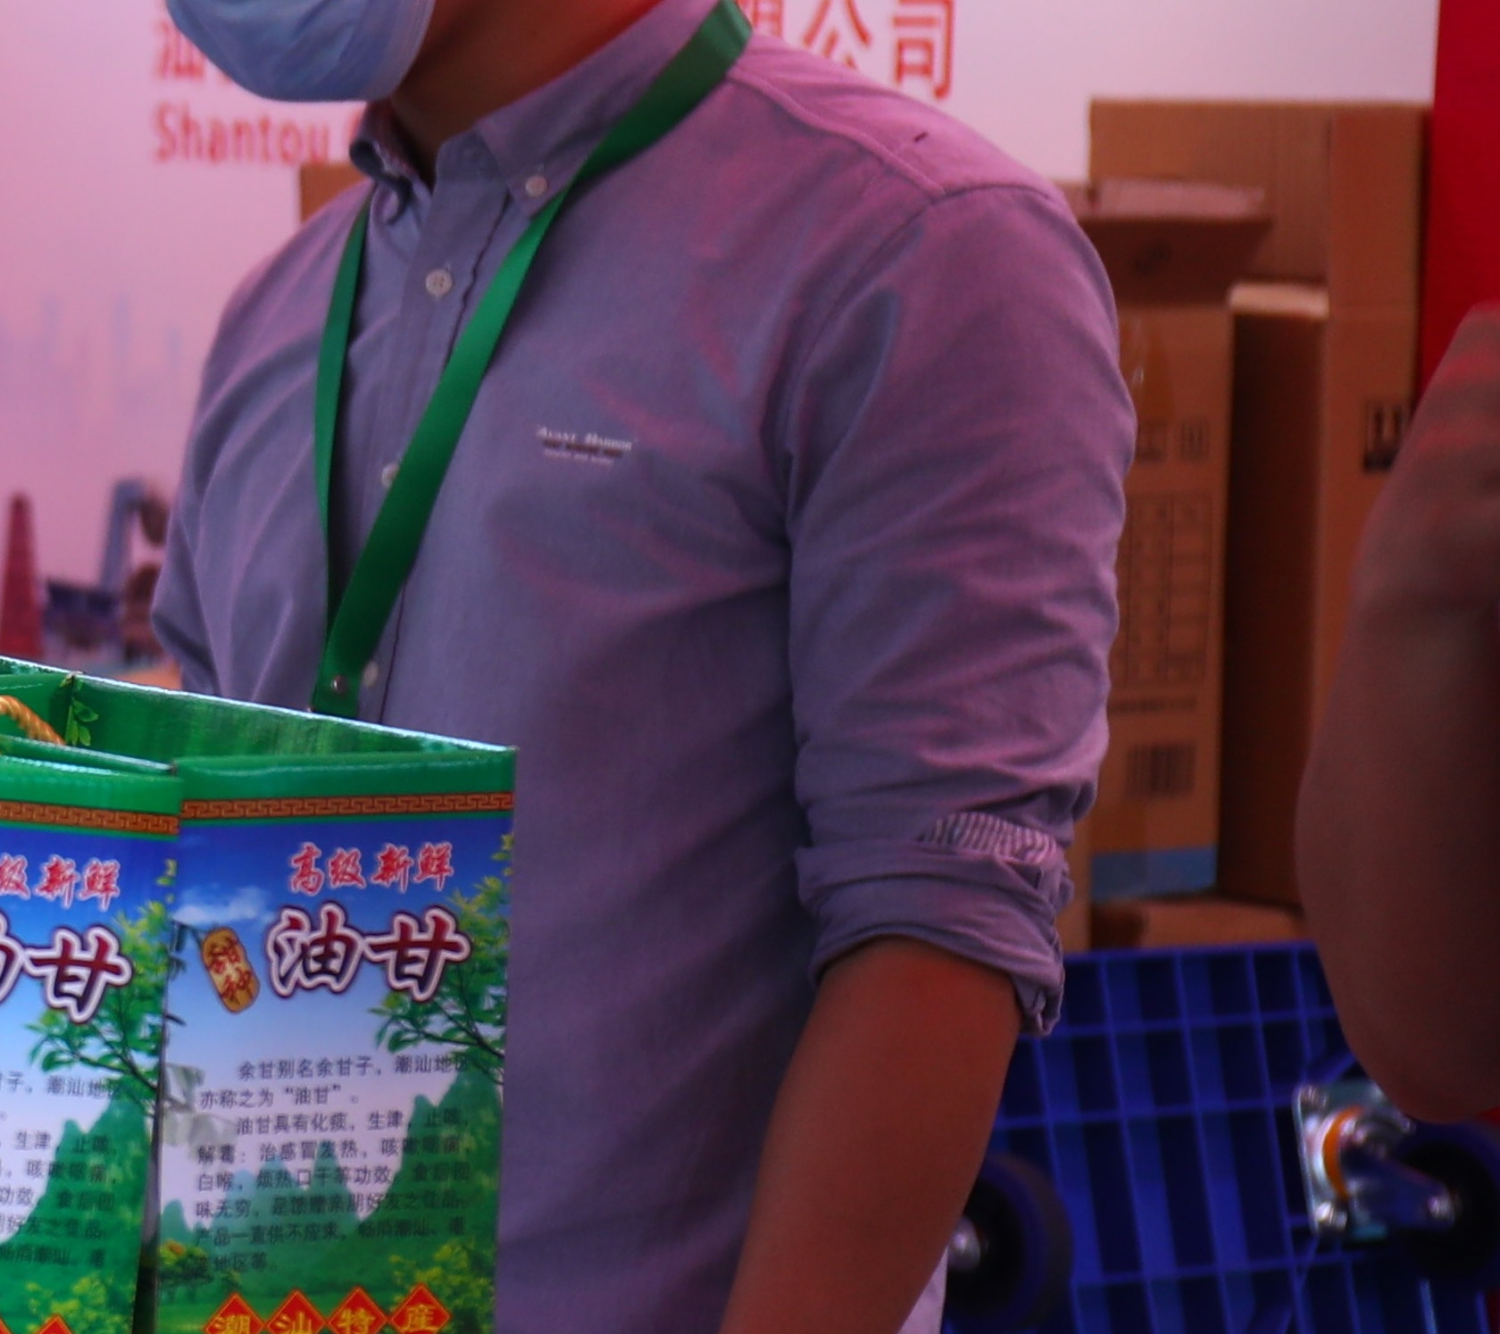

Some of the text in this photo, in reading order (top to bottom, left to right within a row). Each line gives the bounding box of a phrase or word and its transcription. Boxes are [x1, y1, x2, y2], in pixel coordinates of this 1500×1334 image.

[153, 104, 331, 168] Shantou
[288, 841, 453, 895] 高级新鲜
[266, 901, 471, 1002] 油甘
